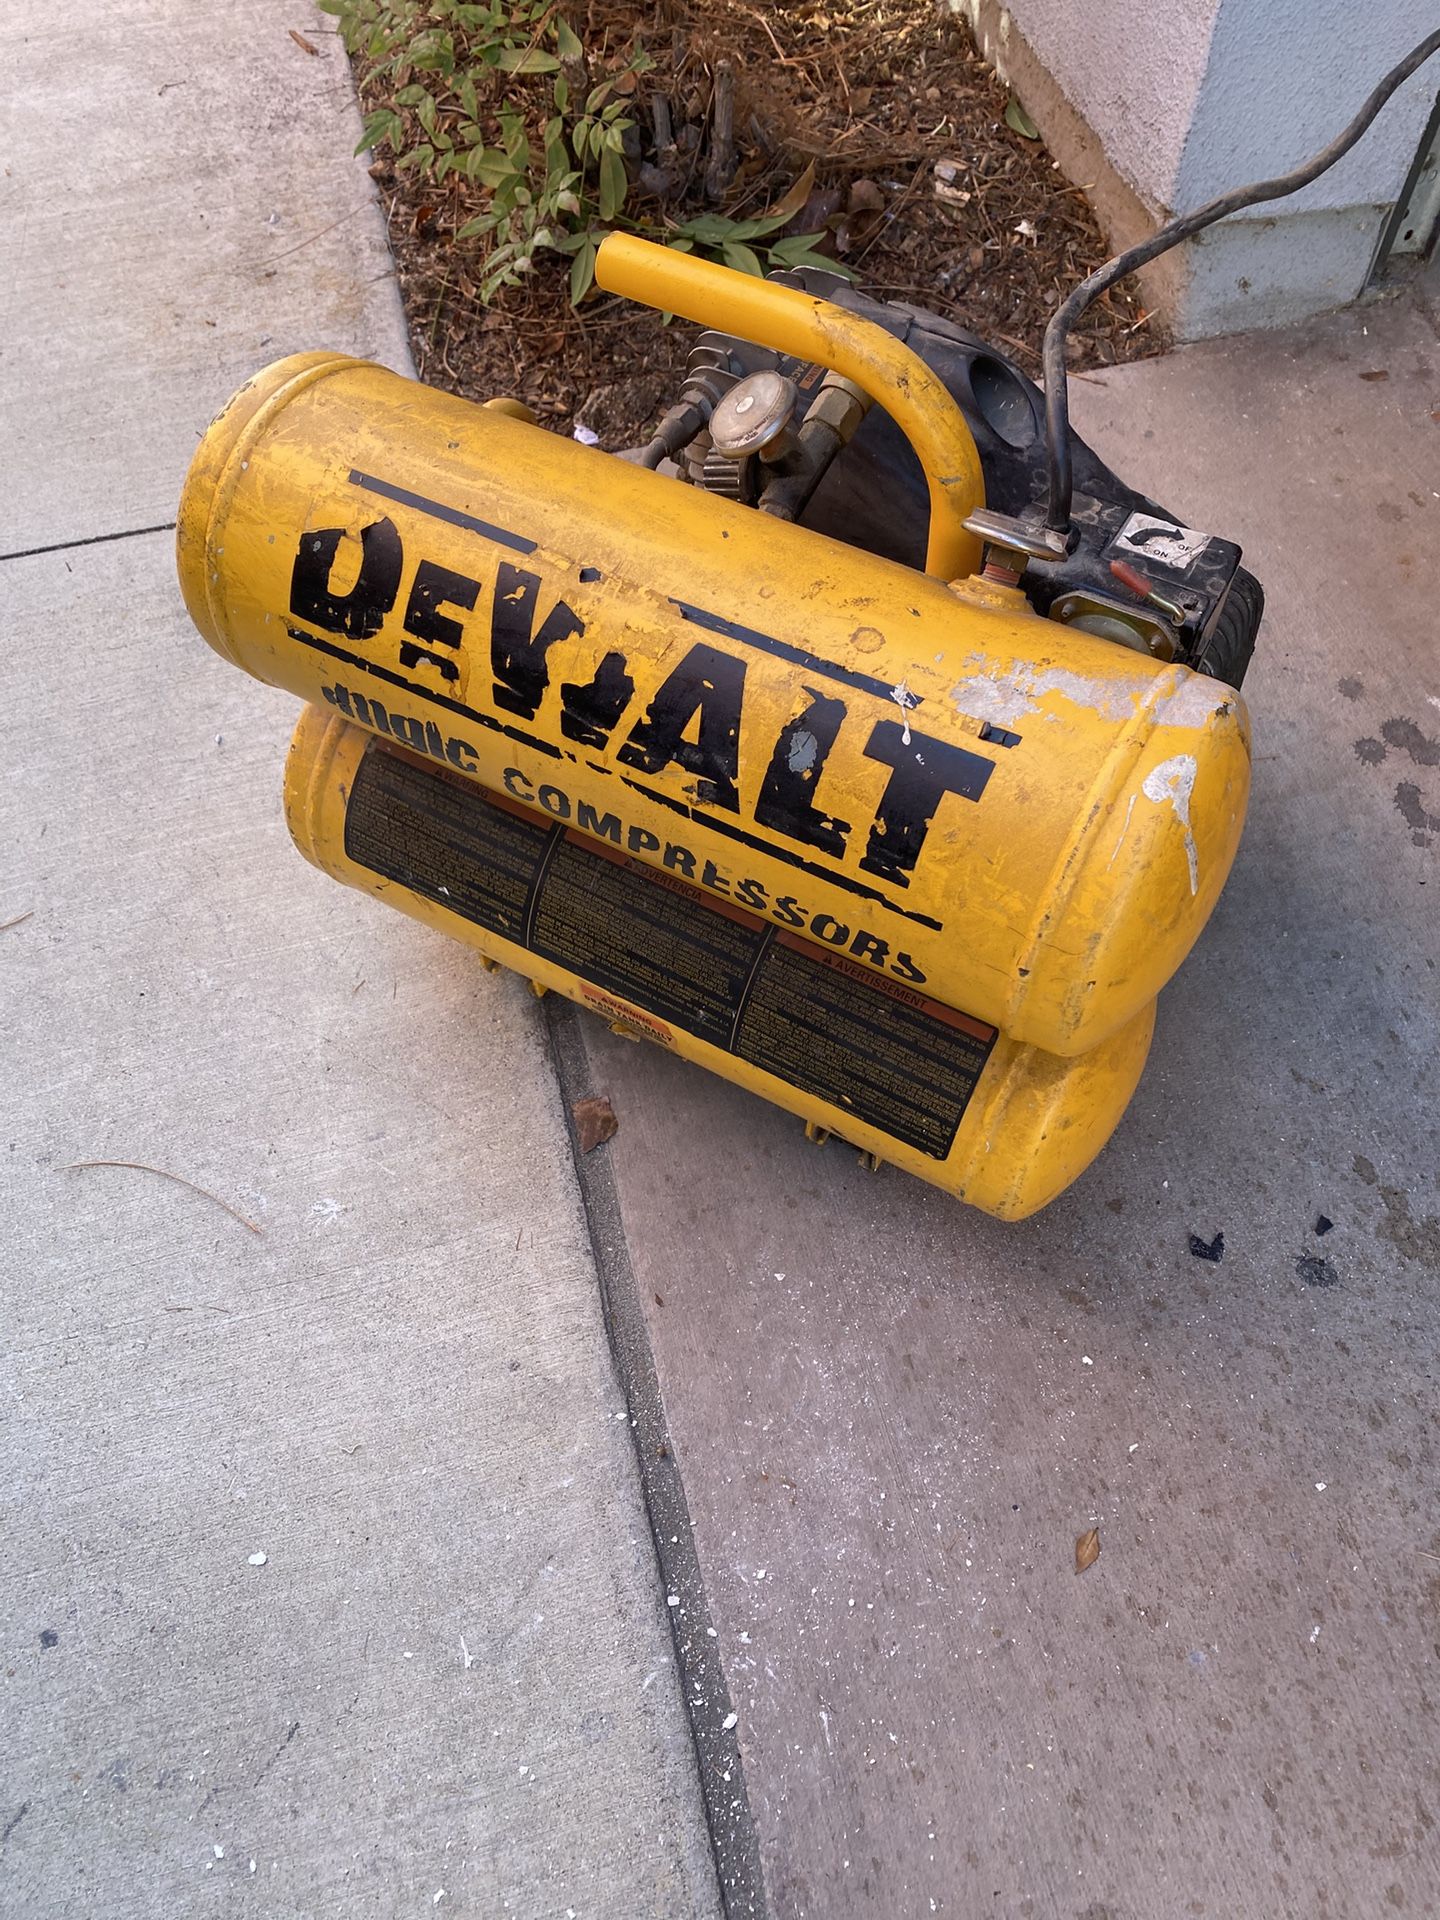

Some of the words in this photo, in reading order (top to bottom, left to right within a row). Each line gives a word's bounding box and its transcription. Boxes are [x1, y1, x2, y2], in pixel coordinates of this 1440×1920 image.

[1153, 549, 1169, 558] ON
[289, 516, 996, 889] DEWALT
[444, 771, 489, 799] WARNING
[502, 766, 927, 984] COMPRESSORS
[631, 862, 702, 900] ADVERTENCIA
[835, 959, 928, 1009] AVERTISSEMENT
[584, 994, 614, 1013] DRAIN
[616, 1009, 642, 1027] TANK
[644, 1024, 673, 1042] DAILY
[608, 1000, 652, 1026] WARNING
